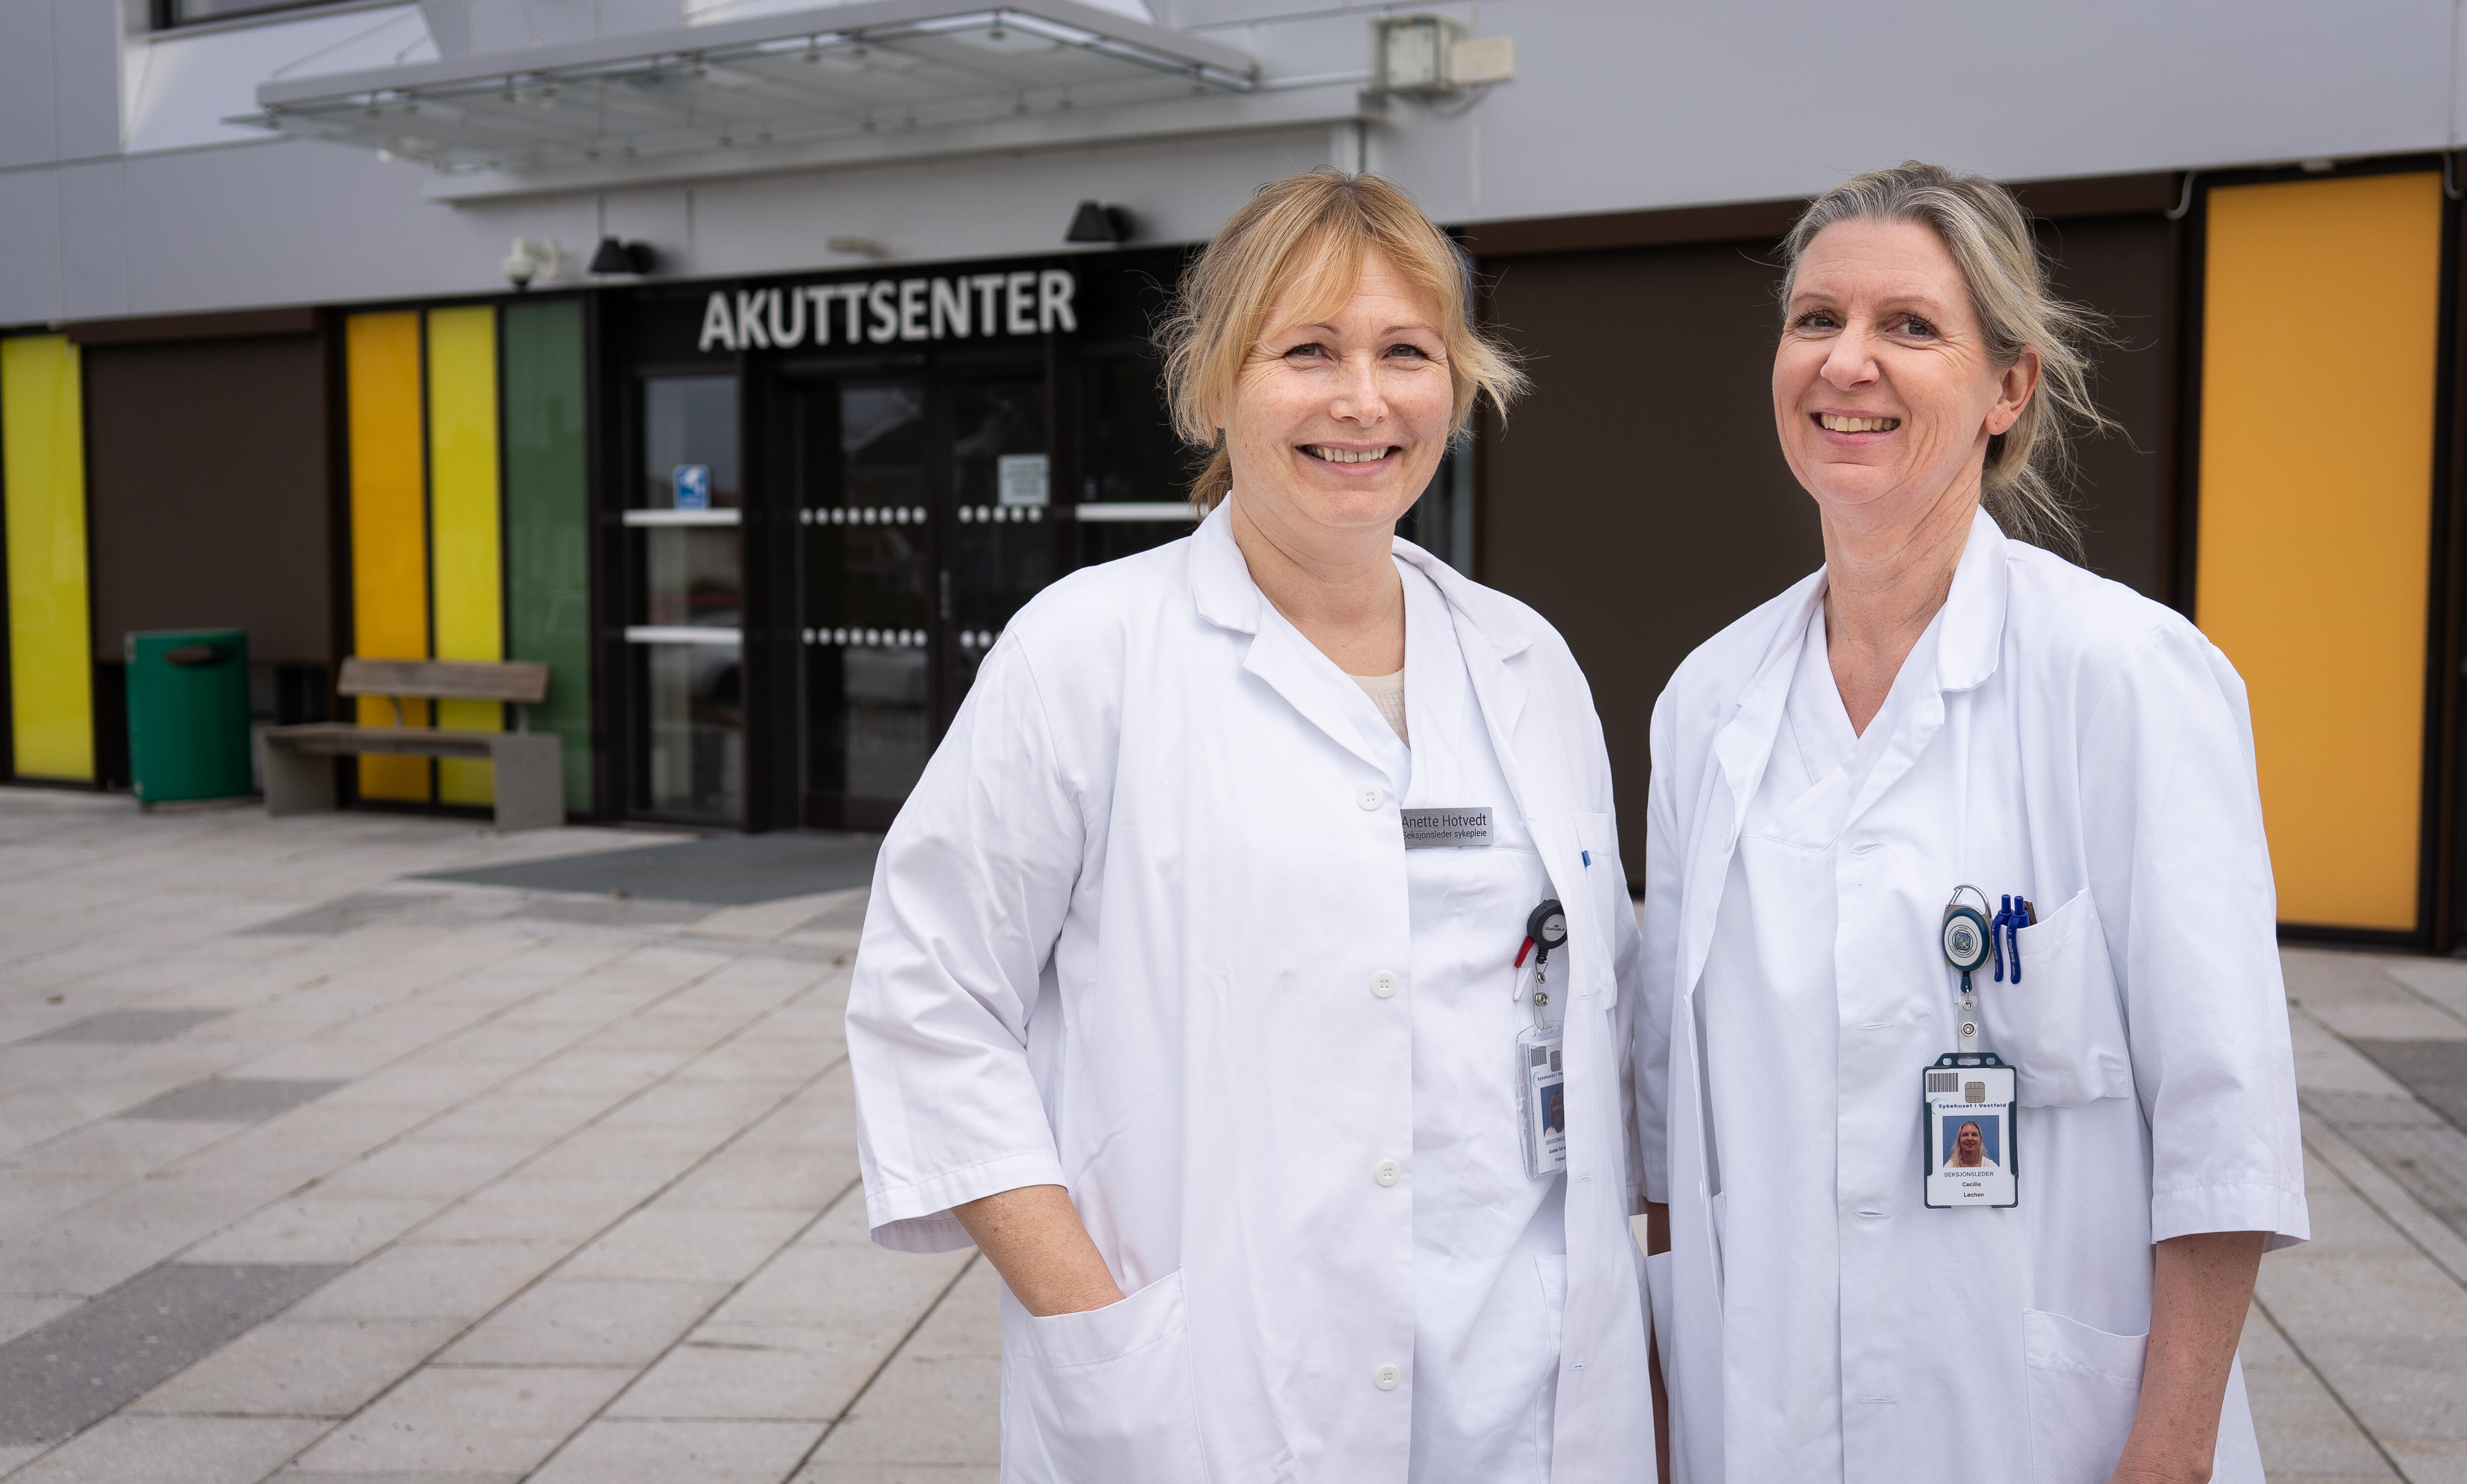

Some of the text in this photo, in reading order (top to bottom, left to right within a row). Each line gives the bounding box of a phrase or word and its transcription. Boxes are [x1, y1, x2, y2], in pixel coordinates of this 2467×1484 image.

[698, 269, 1078, 352] AKUTTSENTER
[1402, 813, 1487, 828] Anette Hotvedt
[1403, 828, 1487, 841] Seksjonsleder sykepleie
[1537, 1073, 1555, 1081] Sykehuset
